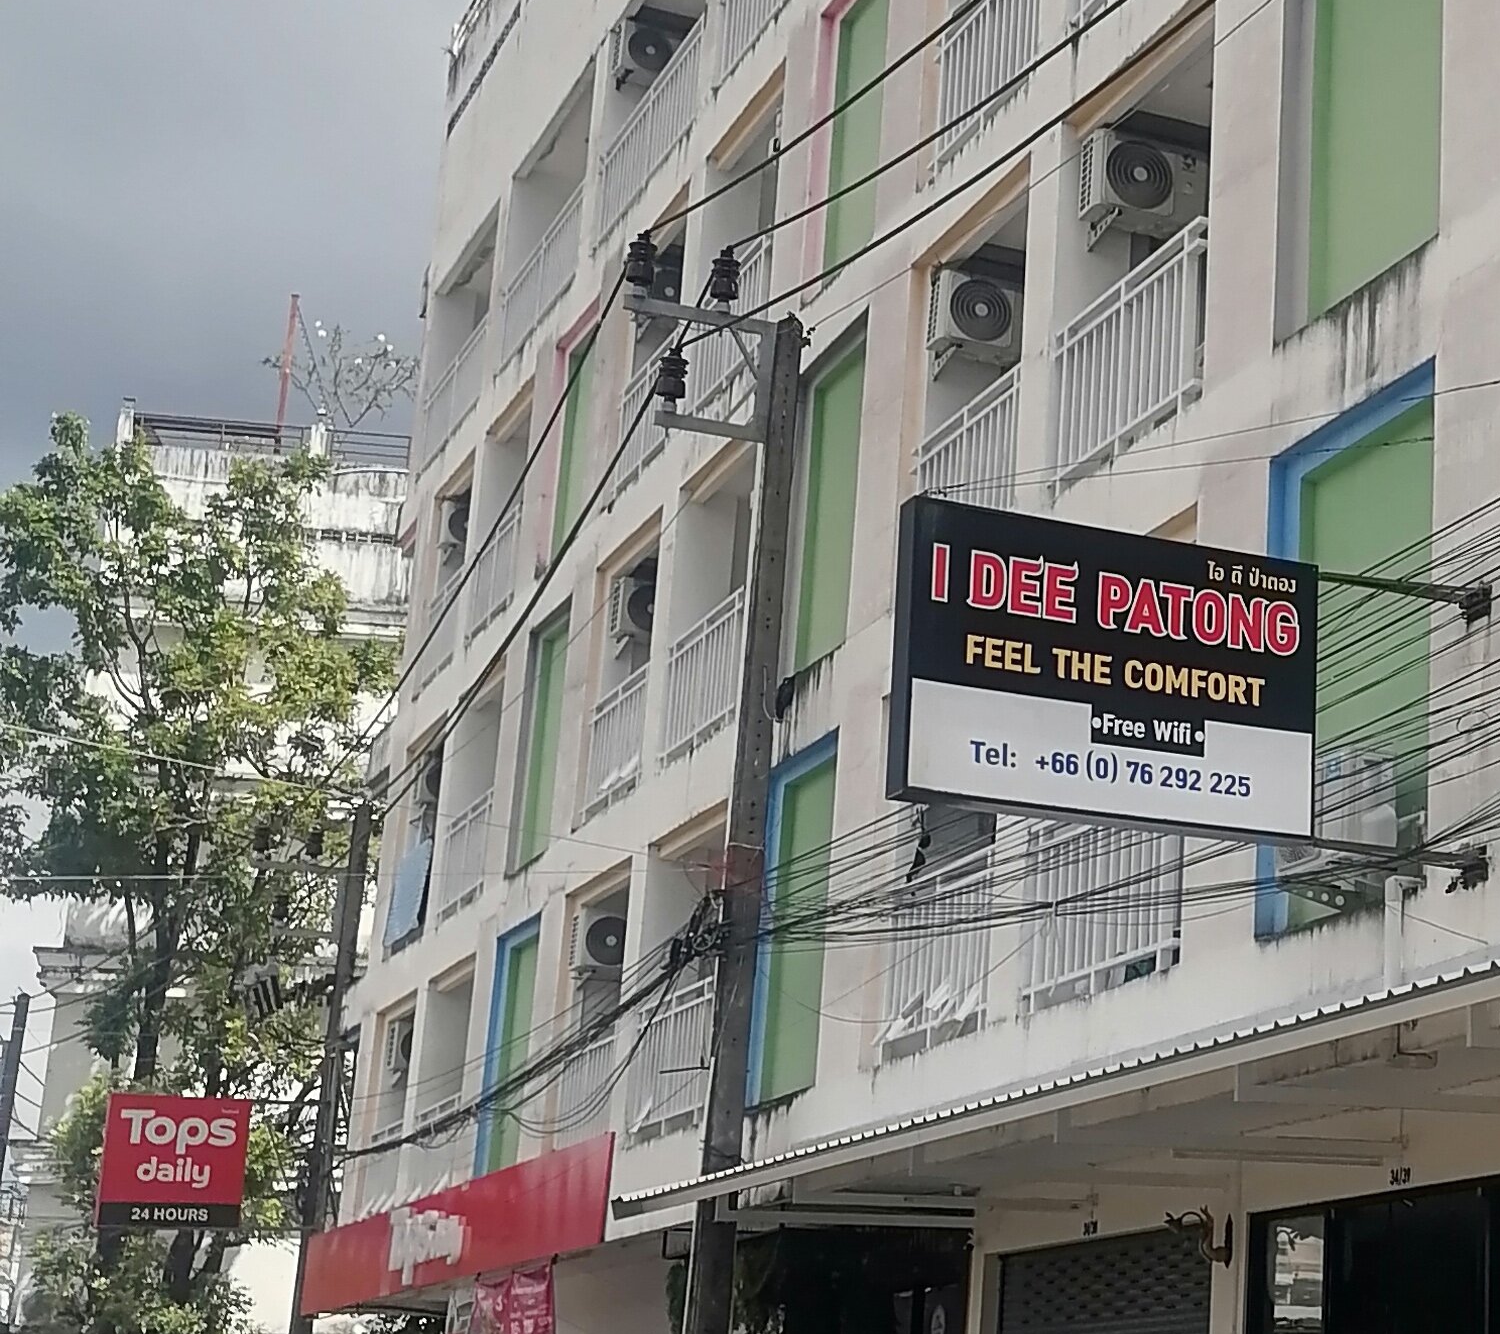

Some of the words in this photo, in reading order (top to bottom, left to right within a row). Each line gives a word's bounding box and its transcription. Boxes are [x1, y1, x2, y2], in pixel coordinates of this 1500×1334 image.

[931, 542, 951, 603] I
[966, 549, 1079, 625] DEE
[1097, 570, 1300, 657] PATONG
[966, 634, 1042, 675] FEEL
[1052, 647, 1112, 685] THE
[1124, 659, 1266, 707] COMFORT
[1102, 713, 1146, 739] Free
[970, 739, 1017, 768] Tel:
[1035, 752, 1079, 776] +66
[1086, 750, 1118, 784] (0)
[1126, 761, 1153, 785] 76
[1160, 766, 1202, 792] 292
[1209, 772, 1251, 797] 225
[120, 1108, 237, 1155] Tops
[136, 1156, 211, 1189] daily
[131, 1207, 150, 1221] 24
[153, 1207, 209, 1222] HOURS
